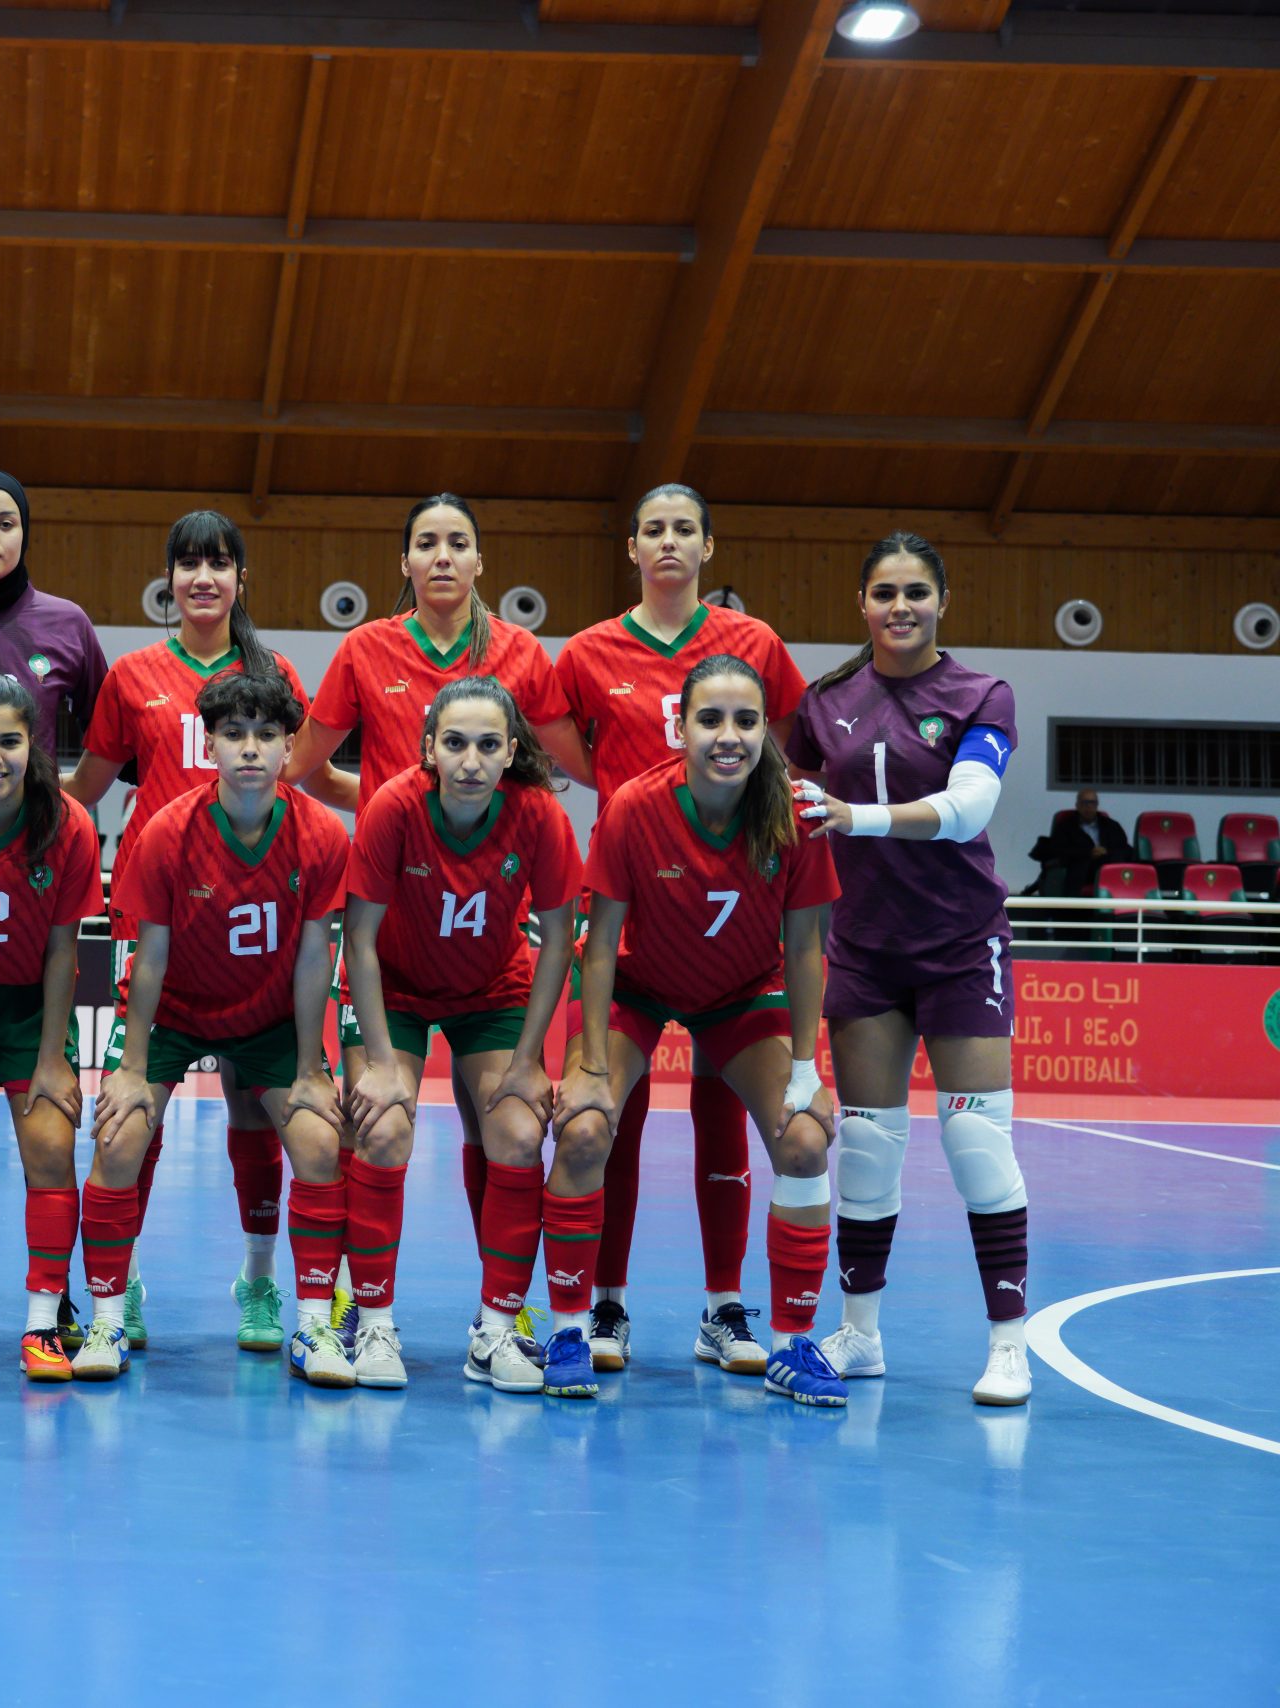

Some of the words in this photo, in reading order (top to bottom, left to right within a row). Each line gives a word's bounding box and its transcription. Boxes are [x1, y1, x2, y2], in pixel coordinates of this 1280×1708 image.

[873, 741, 889, 805] 1
[656, 869, 681, 879] PUMA
[188, 888, 210, 899] PUMA
[439, 890, 487, 938] 14
[703, 890, 740, 937] 7
[228, 901, 278, 956] 21
[986, 936, 1004, 994] 1
[1023, 1055, 1138, 1084] FOOTBALL
[947, 1096, 976, 1110] 181
[300, 1274, 330, 1285] PUMA
[547, 1274, 574, 1286] PUMA
[492, 1297, 522, 1309] PUMA
[785, 1296, 818, 1307] PUMA
